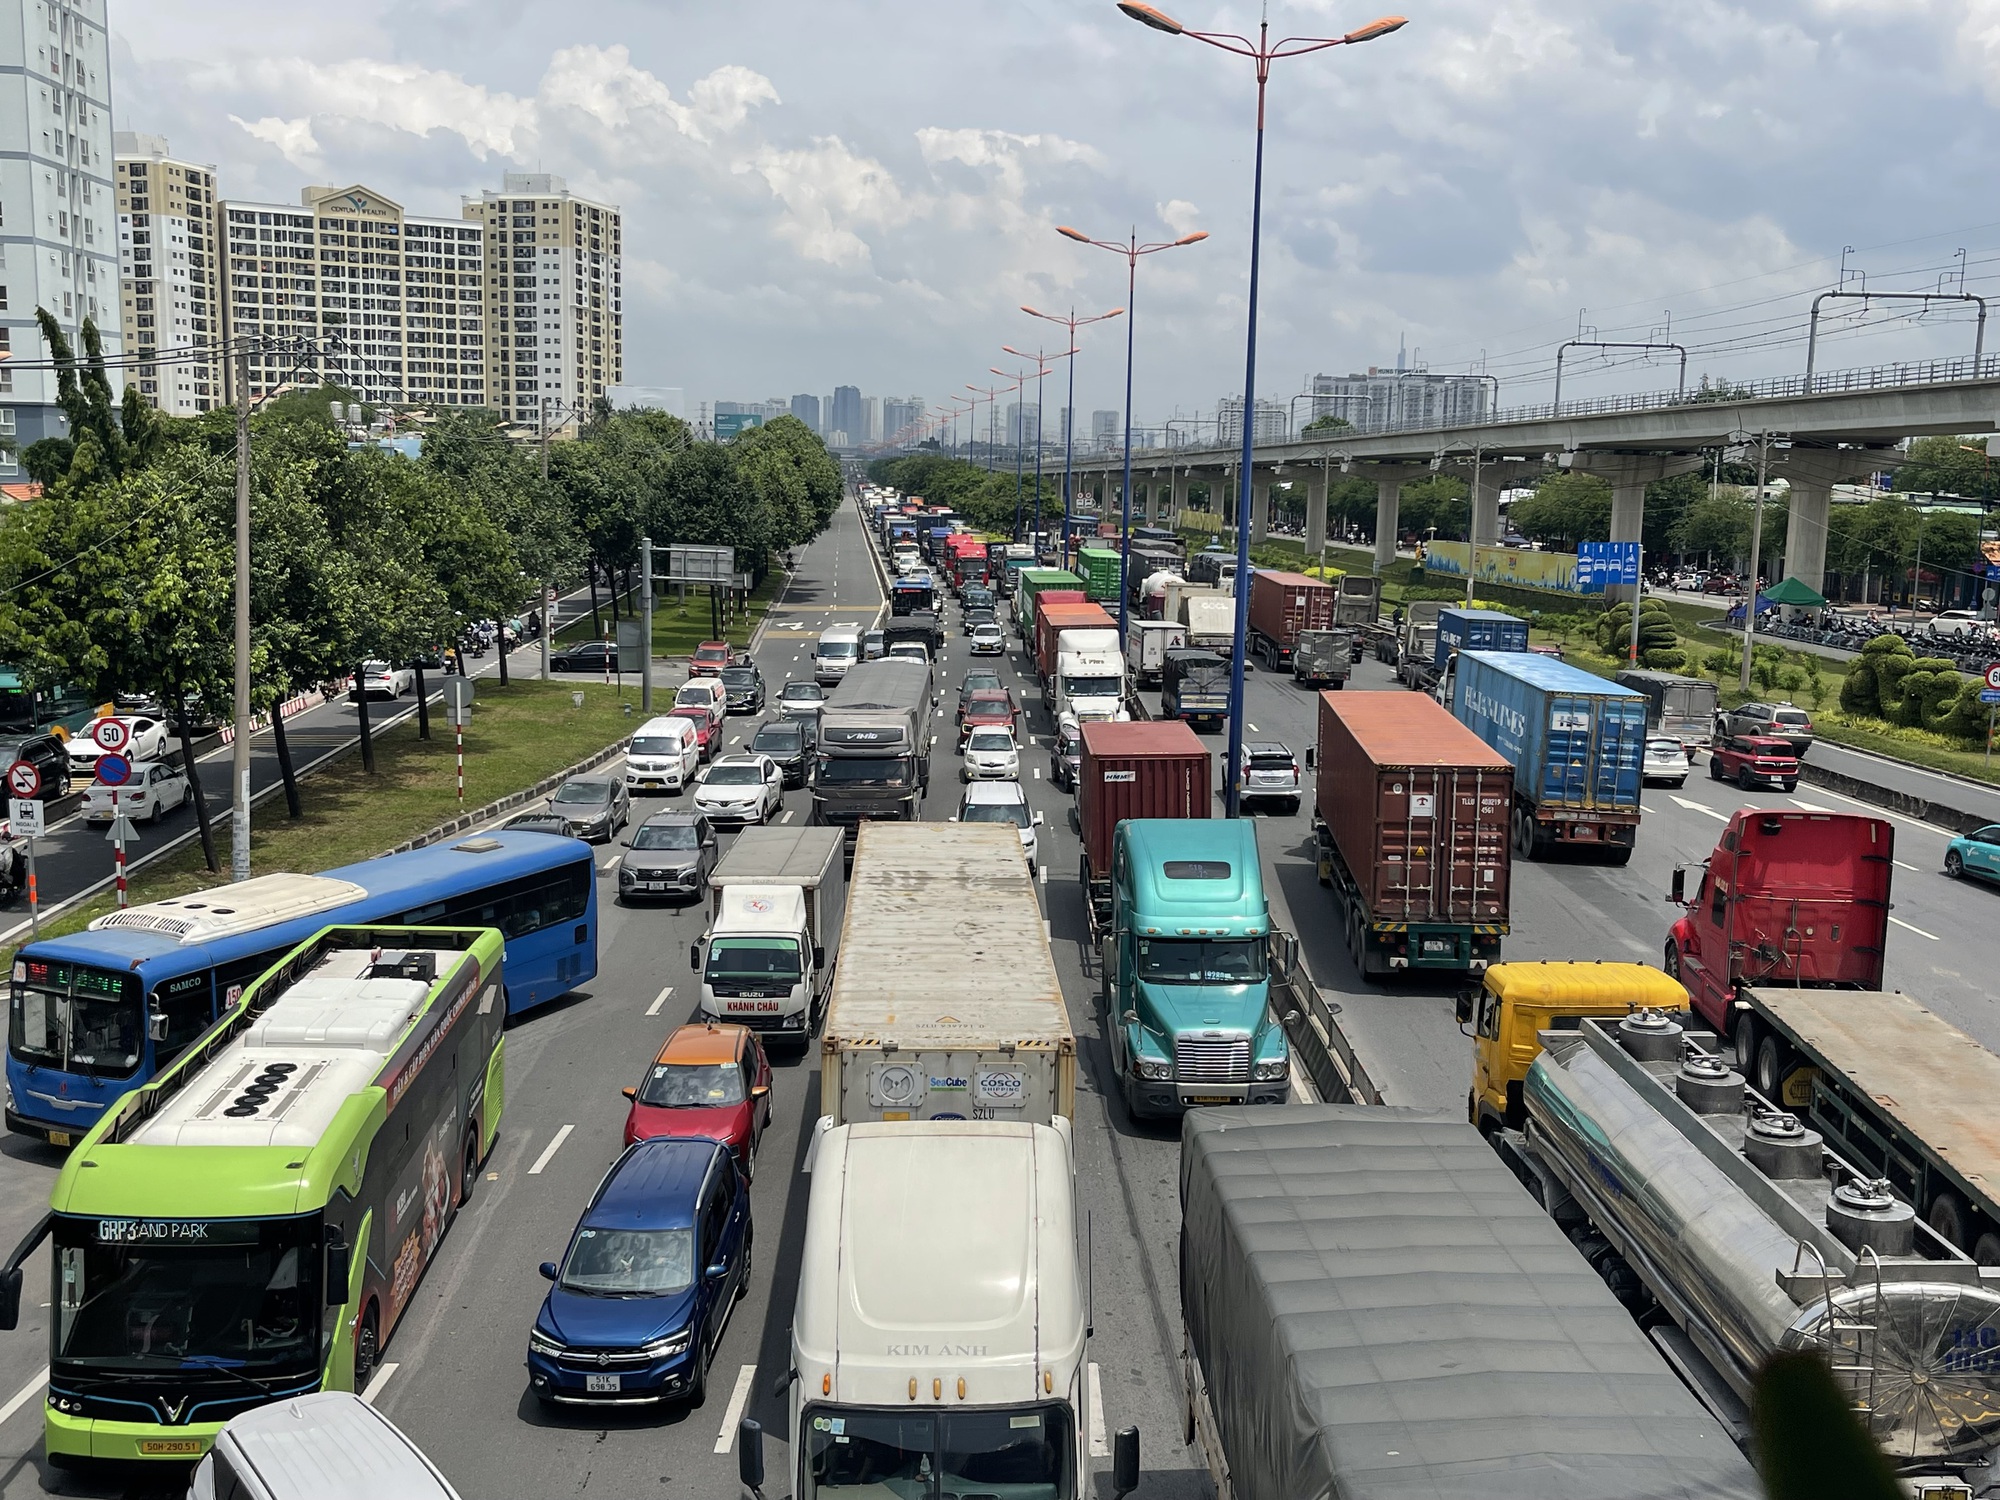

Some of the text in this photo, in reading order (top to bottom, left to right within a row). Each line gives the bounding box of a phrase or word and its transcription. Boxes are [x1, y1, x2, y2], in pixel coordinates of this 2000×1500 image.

[361, 208, 387, 216] WEALTH
[1993, 671, 2000, 682] 6
[103, 728, 119, 742] 50
[170, 977, 201, 993] SAMCO
[727, 1000, 779, 1011] KHÁNH CHÂU
[930, 1077, 967, 1088] SeaCube
[981, 1079, 1021, 1087] COSCO
[973, 1109, 995, 1120] SZLU
[172, 1223, 208, 1238] PARK
[886, 1344, 930, 1356] KIM
[595, 1375, 611, 1383] 51K
